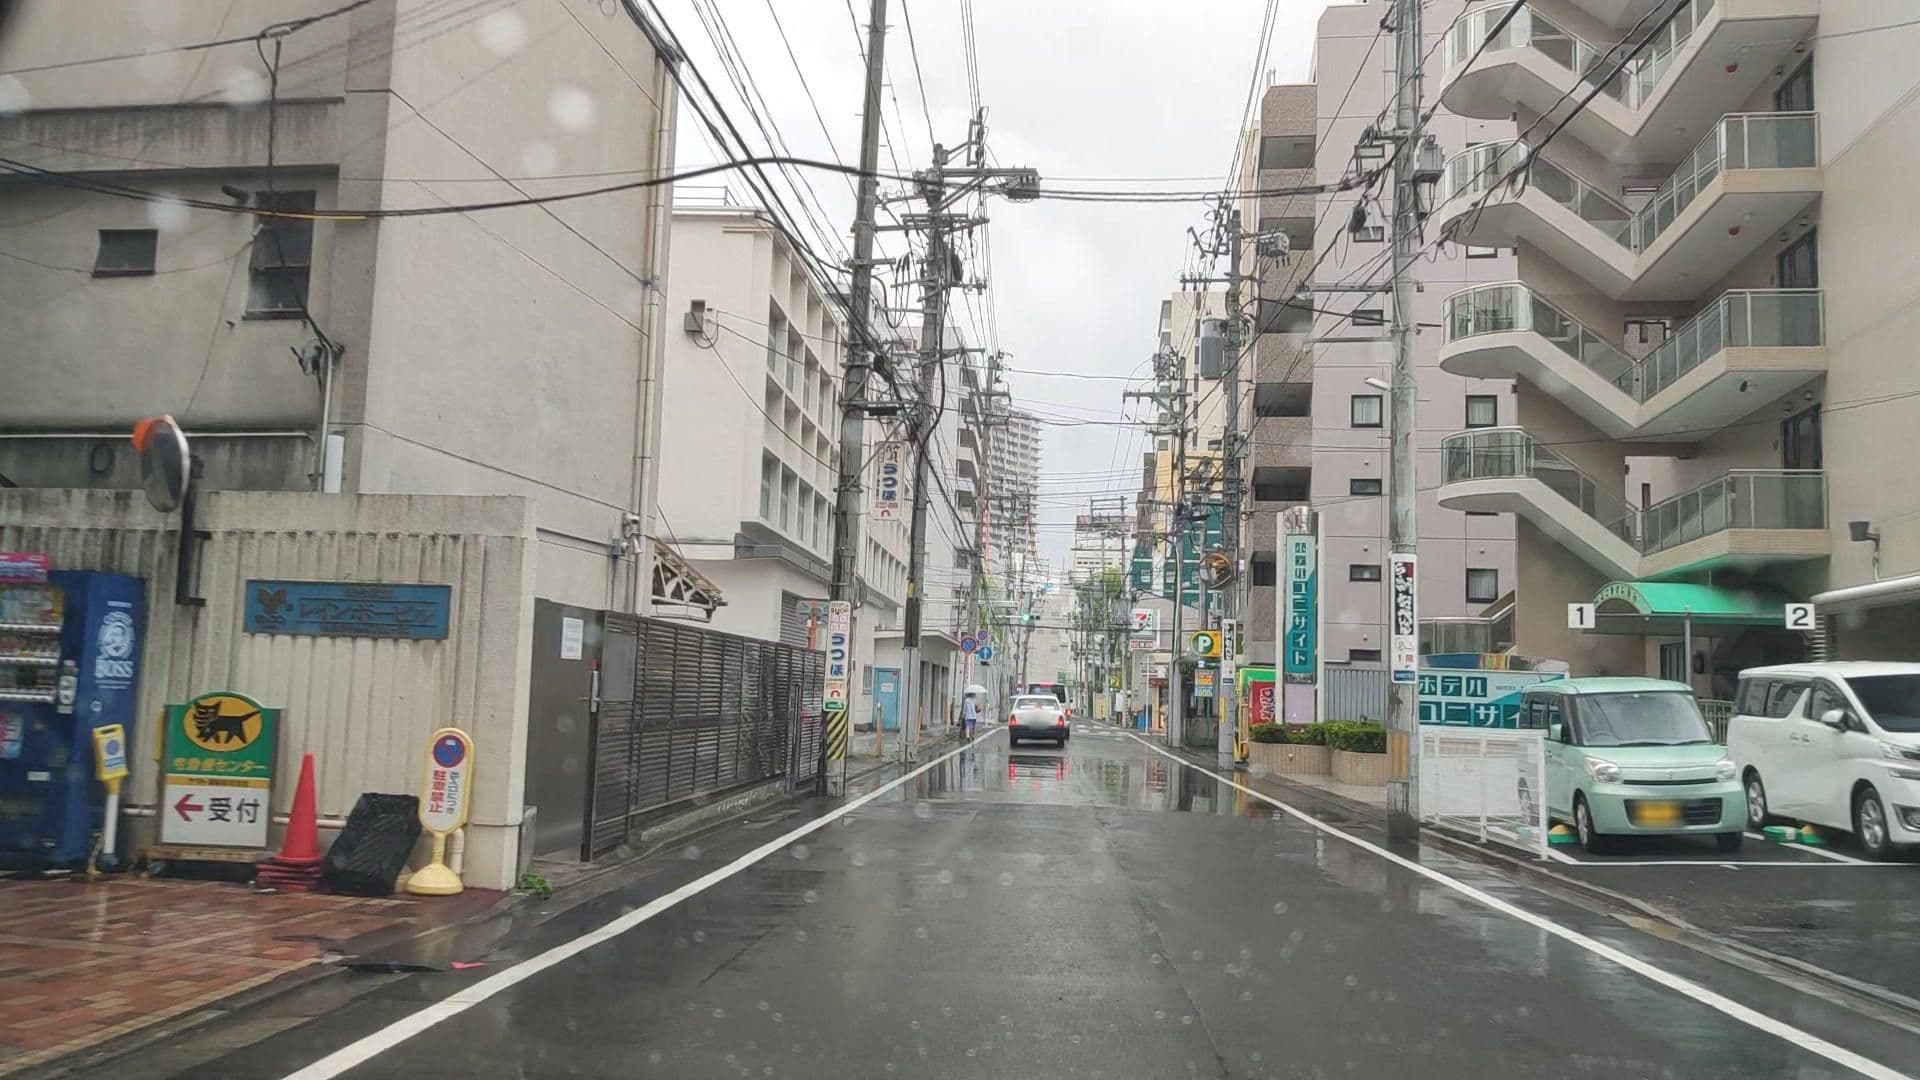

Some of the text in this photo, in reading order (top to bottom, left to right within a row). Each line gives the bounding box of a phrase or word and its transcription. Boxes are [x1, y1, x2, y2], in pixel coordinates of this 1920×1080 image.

[1293, 542, 1307, 665] ホテルユニサイト
[1576, 606, 1584, 626] 1
[1792, 606, 1809, 626] 2
[1198, 635, 1212, 653] P
[1419, 677, 1485, 696] ホテル
[208, 797, 260, 823] 受付
